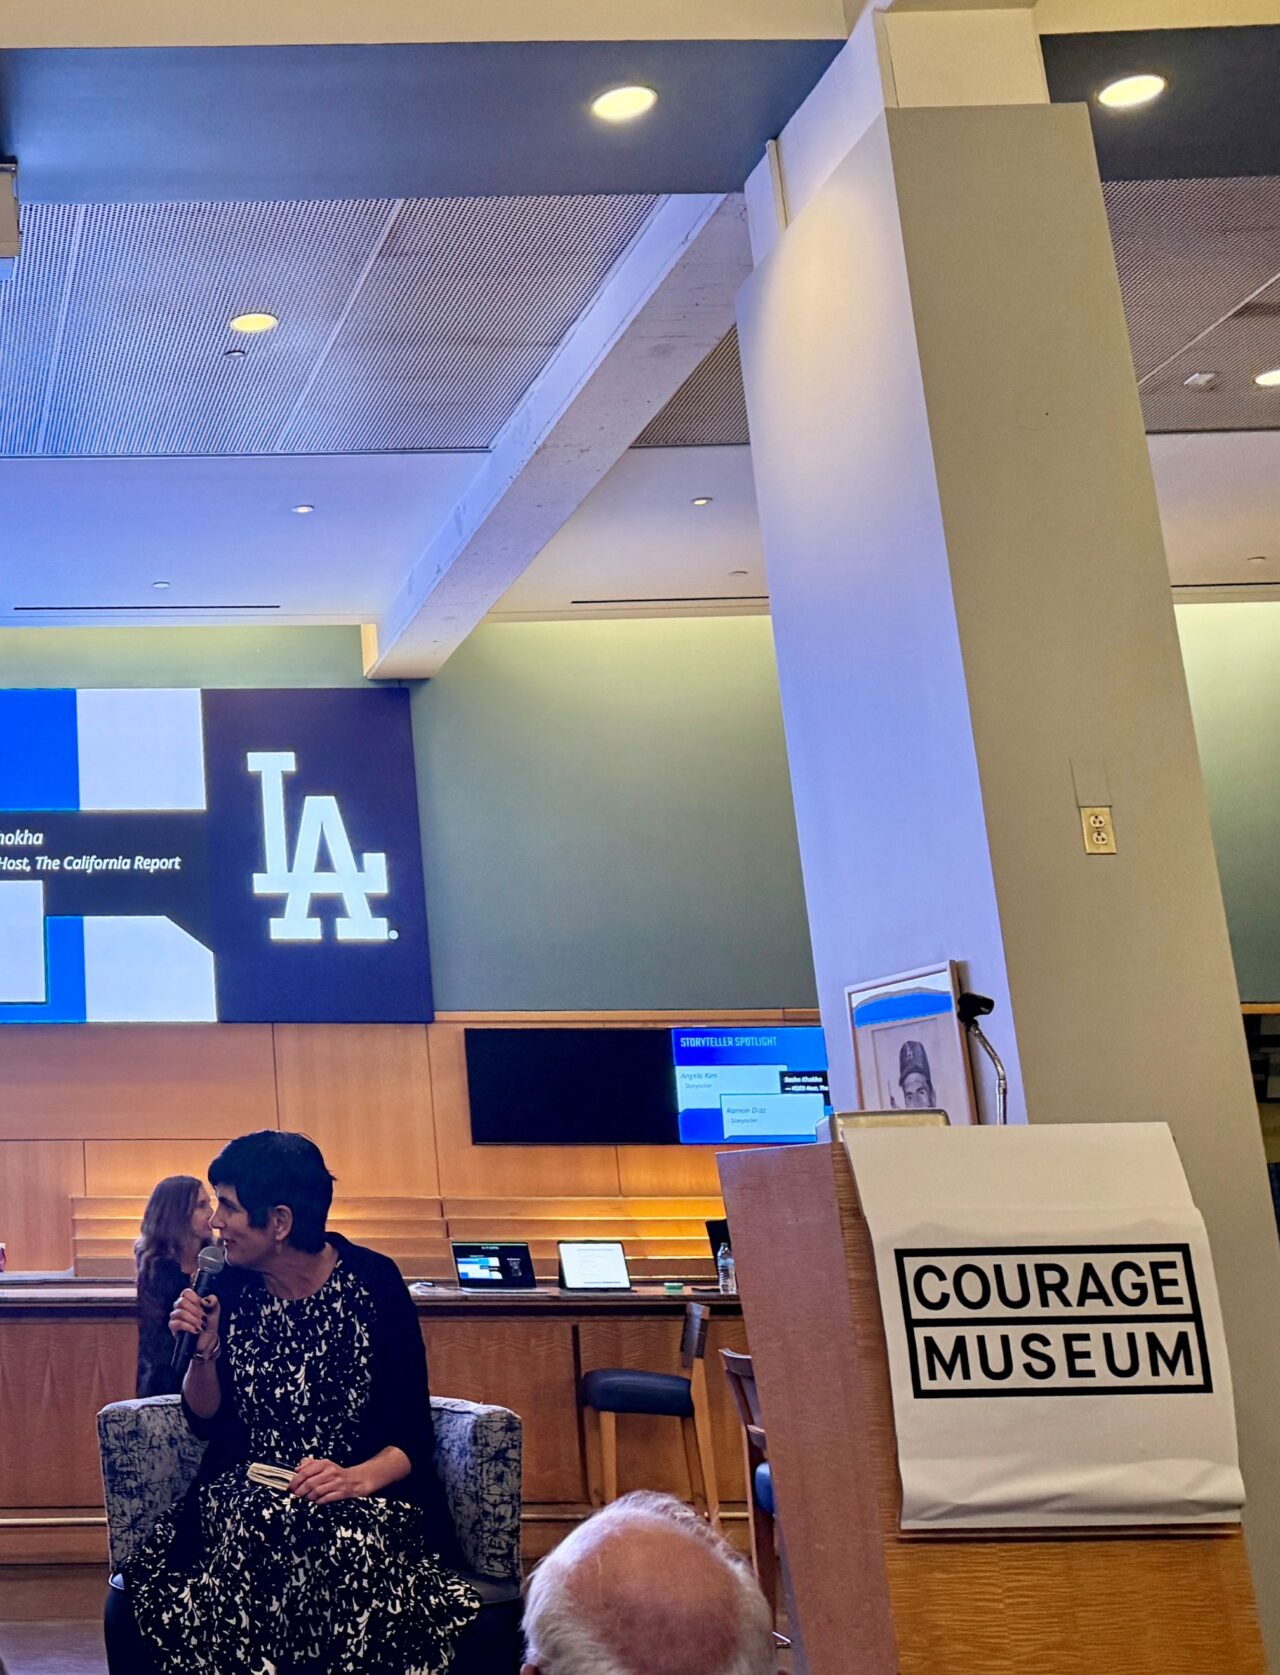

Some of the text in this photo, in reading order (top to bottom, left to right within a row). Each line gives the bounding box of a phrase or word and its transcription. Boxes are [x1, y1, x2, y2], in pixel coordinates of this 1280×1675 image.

[35, 856, 60, 871] The
[63, 855, 131, 874] California
[133, 855, 182, 873] Report
[247, 751, 389, 940] LA
[680, 1036, 777, 1048] STORYTELLER SPOTLIGHT
[913, 1260, 1184, 1311] COURAGE
[923, 1331, 1194, 1381] MUSEUM
